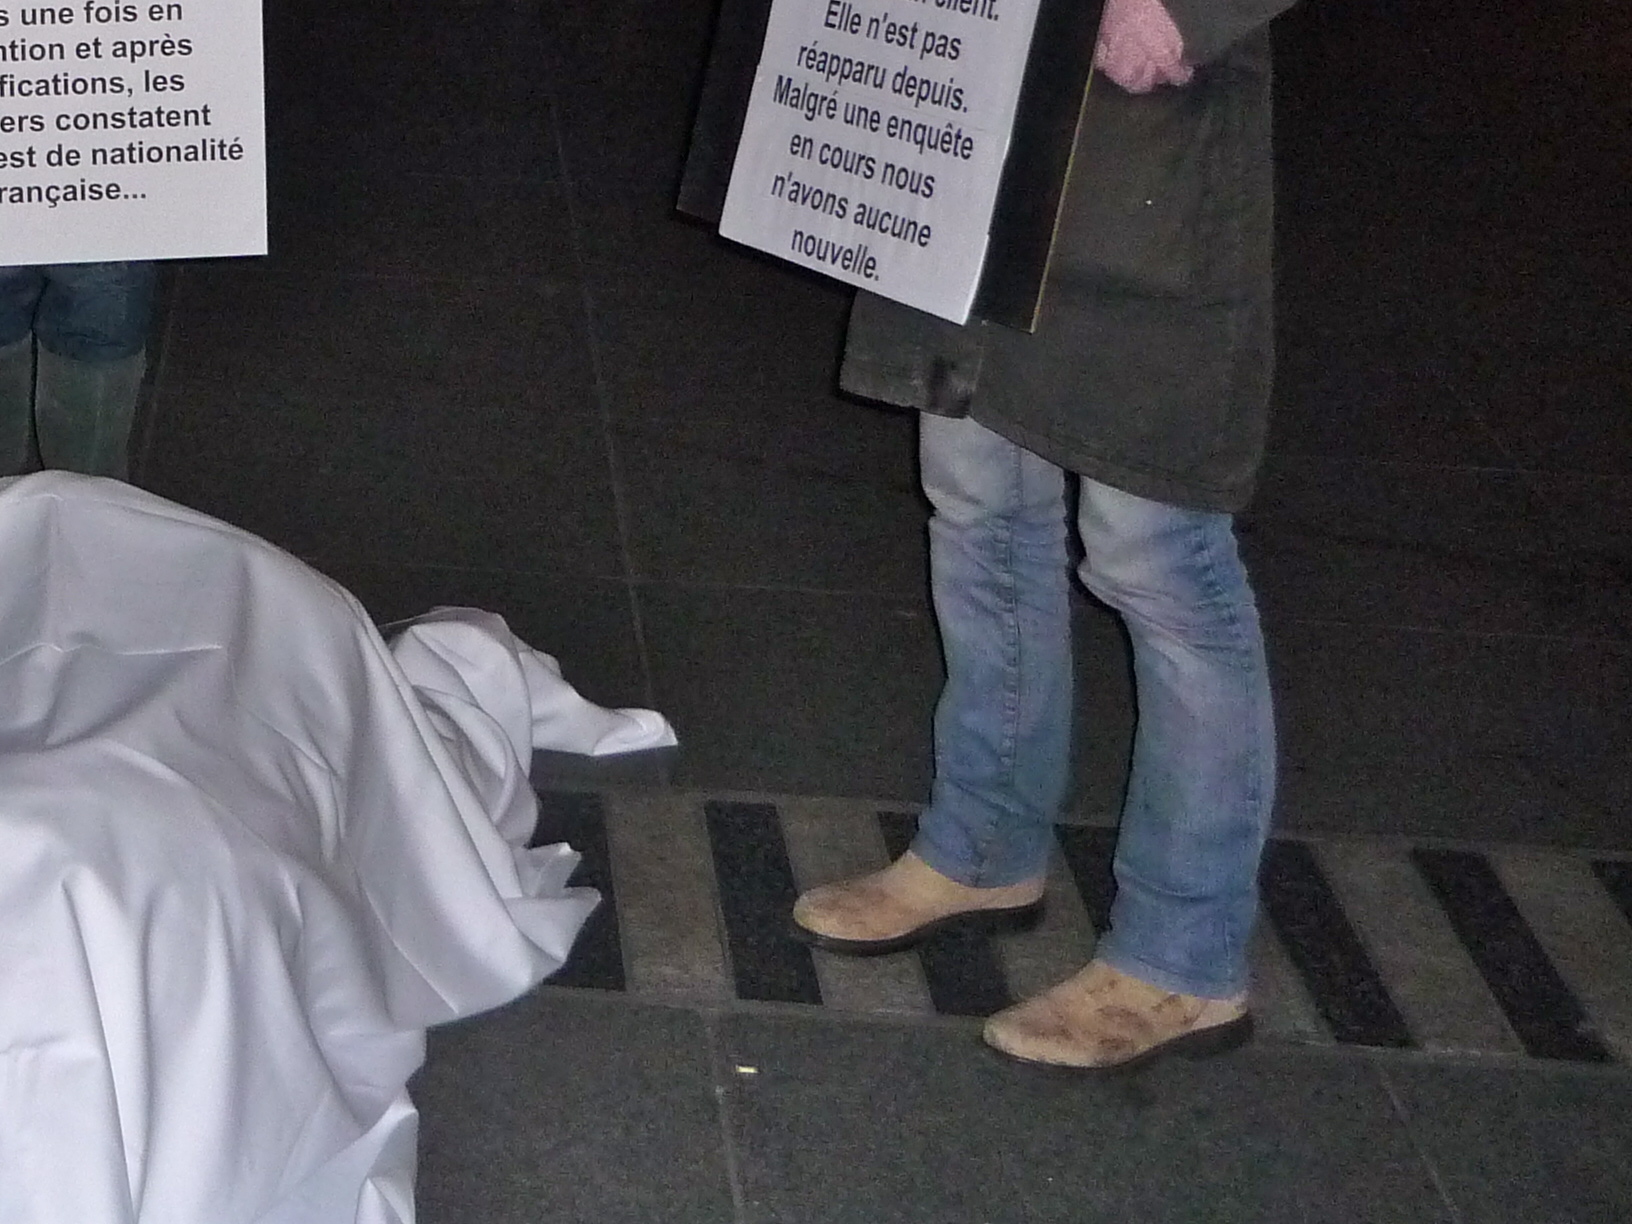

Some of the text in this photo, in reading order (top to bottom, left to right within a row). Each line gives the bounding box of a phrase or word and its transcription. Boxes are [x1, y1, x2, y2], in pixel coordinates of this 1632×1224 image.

[20, 6, 75, 26] une
[82, 0, 139, 24] fois
[148, 3, 183, 22] en
[865, 12, 919, 51] n'est
[919, 30, 963, 61] pas
[75, 36, 104, 60] et
[111, 32, 193, 64] après
[144, 68, 186, 93] les
[796, 40, 968, 114] réapparu depuis.
[55, 103, 212, 132] constatent
[772, 74, 974, 161] Malgré une enquête
[45, 142, 82, 168] de
[91, 136, 244, 166] nationalité
[789, 133, 936, 199] en cours nous
[770, 170, 932, 248] n'avons aucune
[790, 228, 880, 282] nouvelle.
